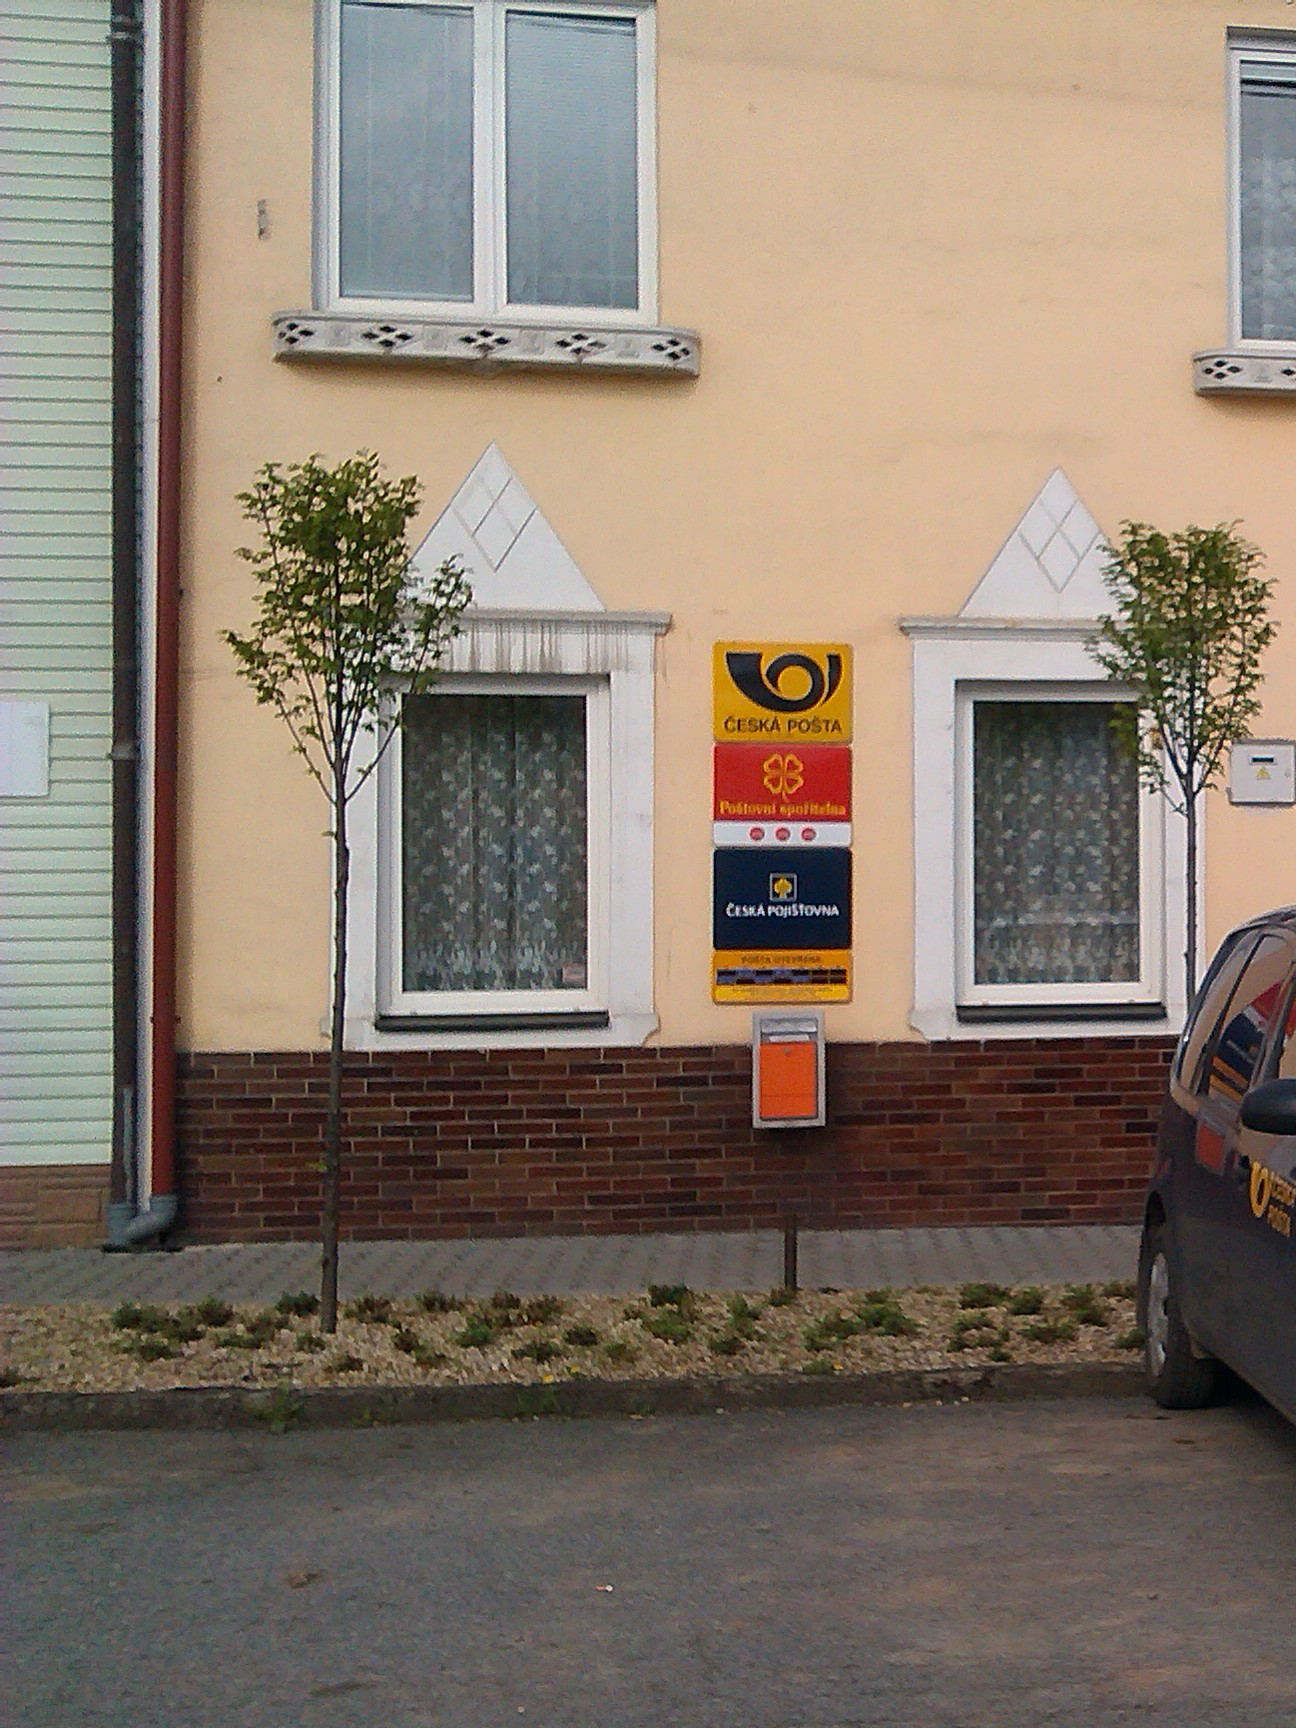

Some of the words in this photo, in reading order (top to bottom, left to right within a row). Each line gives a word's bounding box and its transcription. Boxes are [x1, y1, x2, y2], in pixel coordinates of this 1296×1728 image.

[723, 714, 781, 733] ČESKÁ
[787, 715, 843, 734] POŠTA
[725, 902, 766, 918] ČESKÁ
